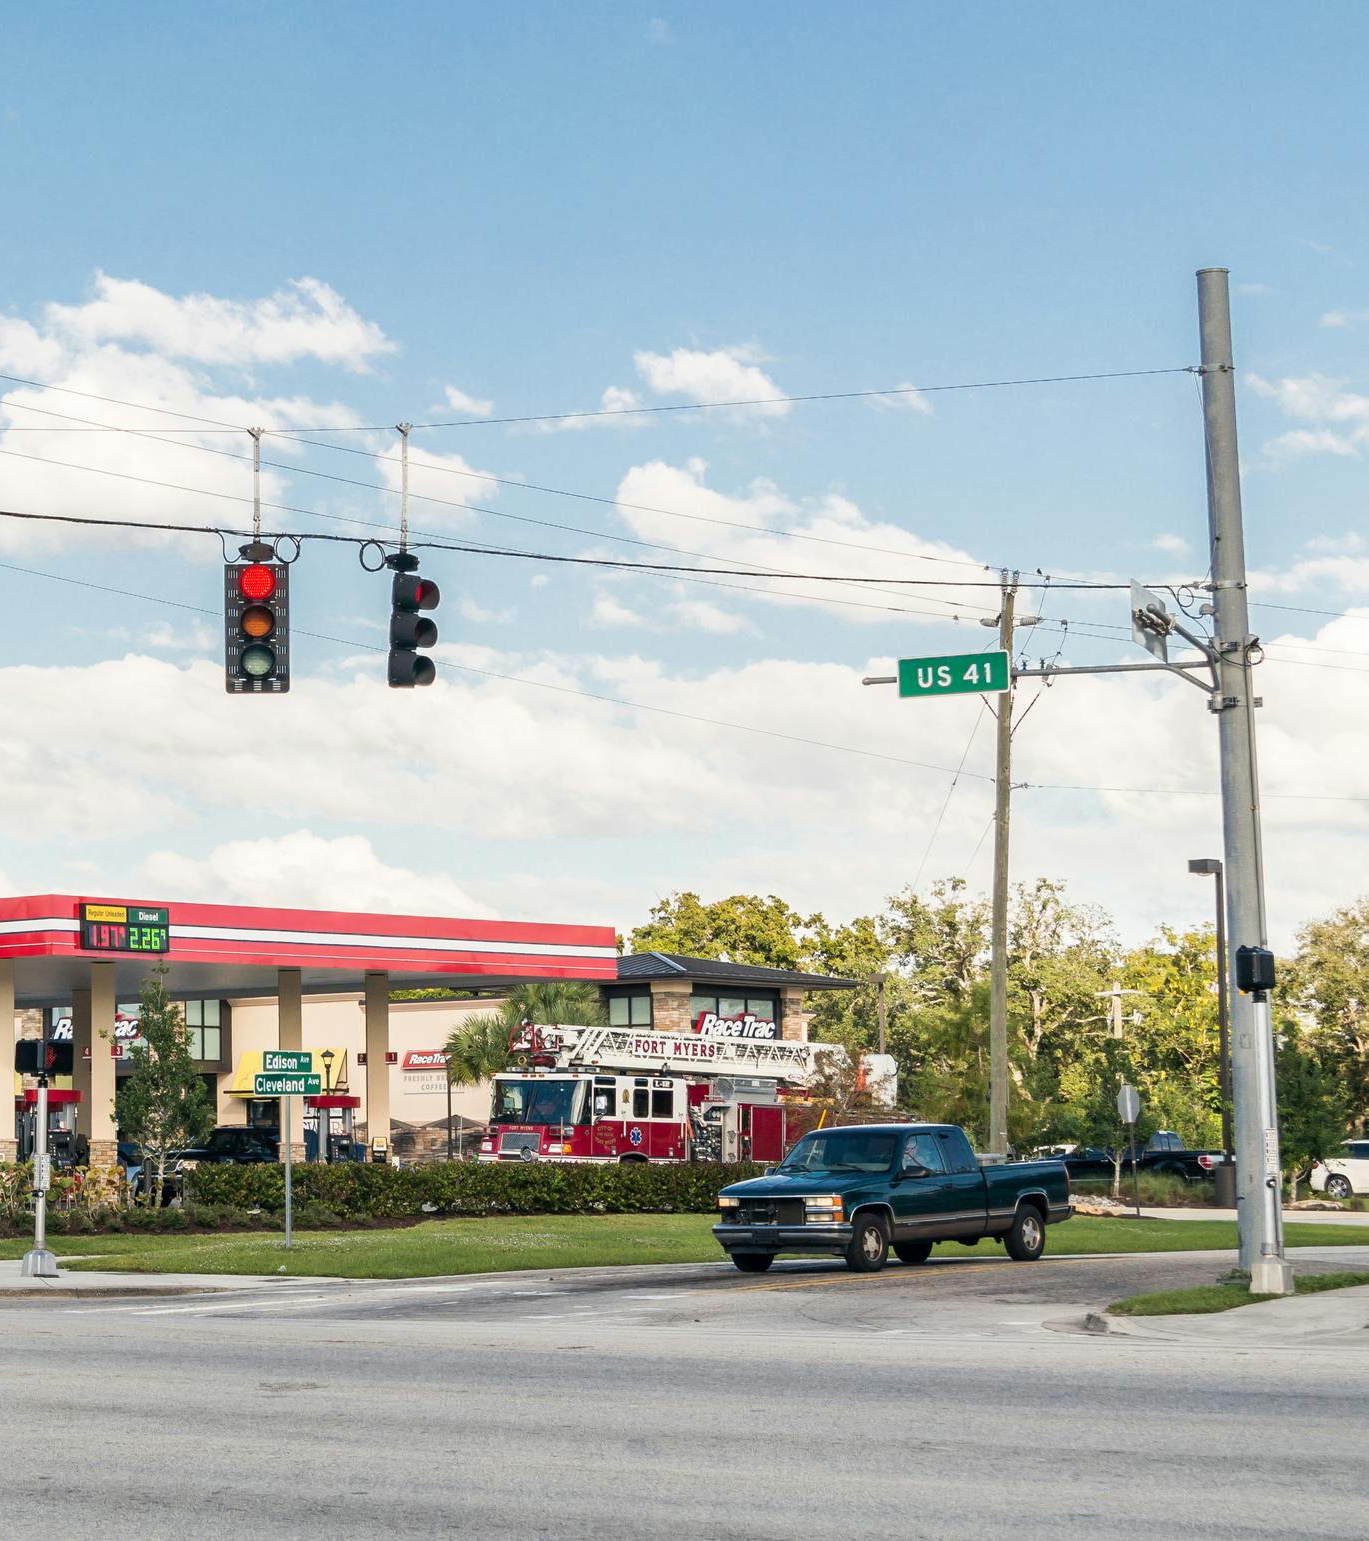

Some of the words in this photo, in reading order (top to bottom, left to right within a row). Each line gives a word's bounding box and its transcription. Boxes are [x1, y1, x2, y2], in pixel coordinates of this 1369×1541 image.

[917, 665, 952, 688] US
[963, 662, 991, 685] 41
[88, 908, 104, 917] Regular
[105, 910, 125, 918] Unleaded
[138, 911, 159, 922] Diesel
[700, 1013, 776, 1039] RaceTrac
[634, 1039, 666, 1054] FORT
[674, 1041, 715, 1058] MYERS
[266, 1054, 298, 1070] Edison
[300, 1055, 310, 1064] Ave
[256, 1077, 305, 1092] Cleveland
[307, 1077, 320, 1085] Ave
[403, 1075, 433, 1083] FRESHLY
